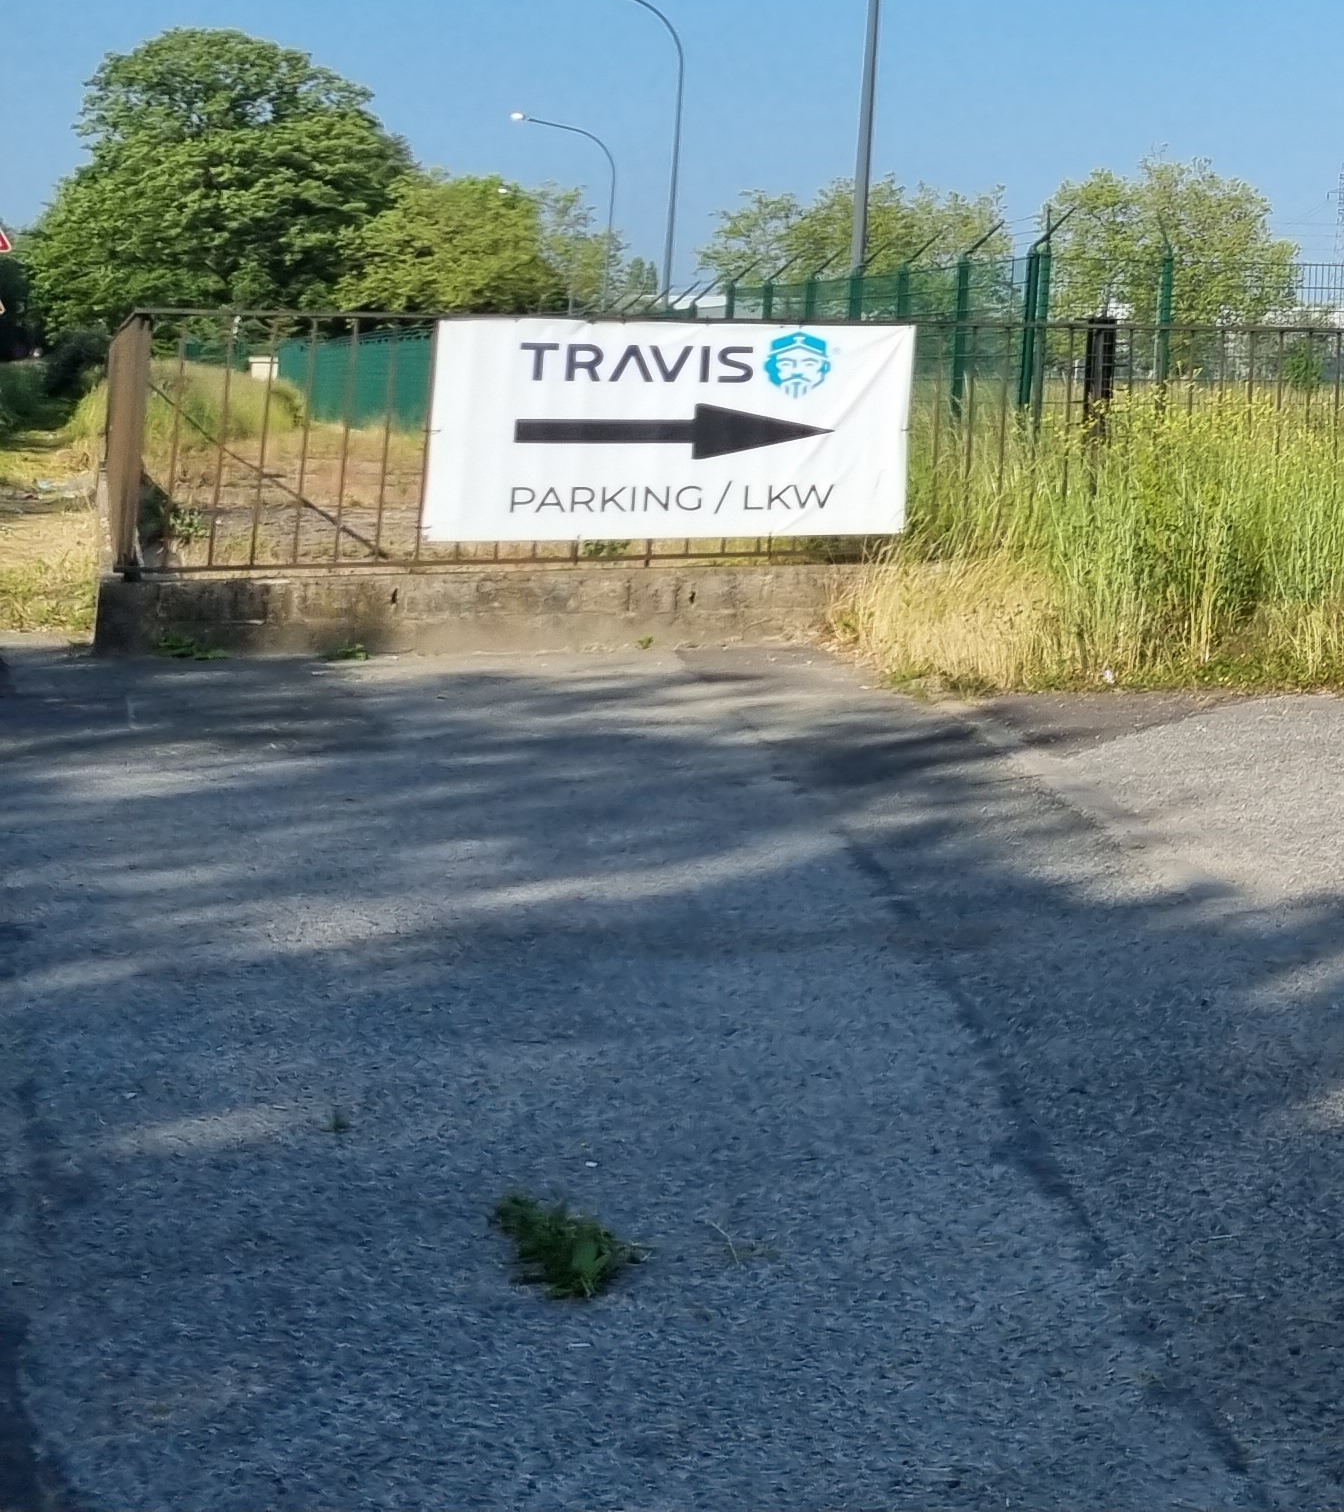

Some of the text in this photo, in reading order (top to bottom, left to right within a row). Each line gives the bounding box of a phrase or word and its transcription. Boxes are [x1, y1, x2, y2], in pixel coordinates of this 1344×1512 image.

[520, 342, 754, 384] TRAVIS
[509, 484, 702, 514] PARKING
[743, 483, 836, 512] LKW
